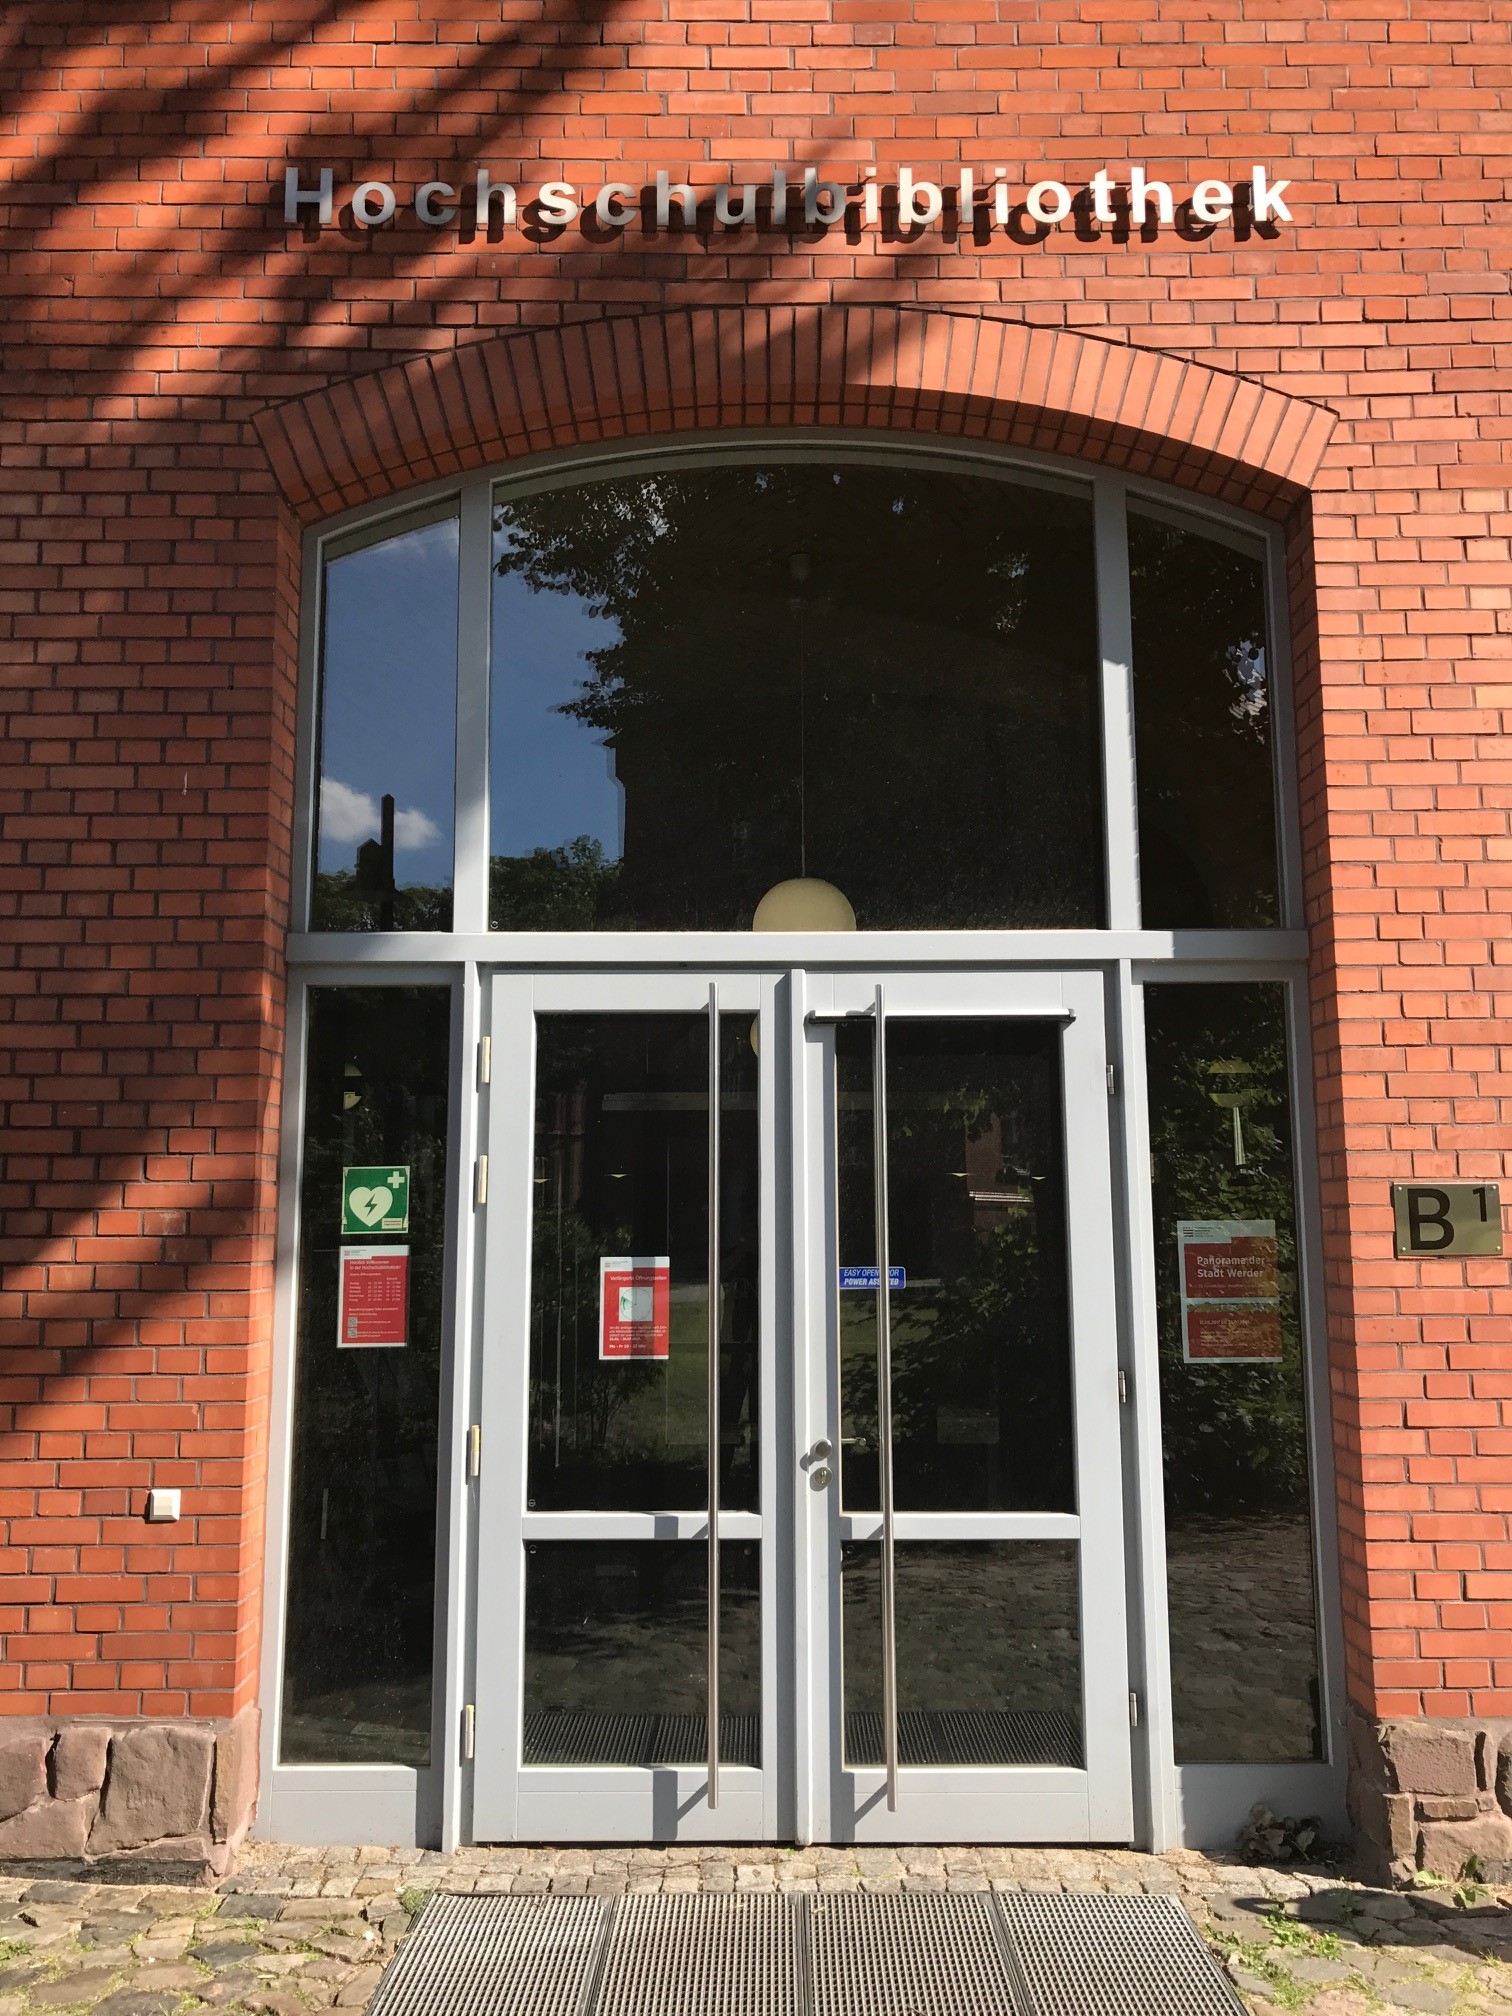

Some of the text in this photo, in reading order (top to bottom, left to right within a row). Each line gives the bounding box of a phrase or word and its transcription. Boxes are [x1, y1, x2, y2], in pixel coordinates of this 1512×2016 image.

[283, 165, 1294, 226] Hochschulbibliothek
[1407, 1186, 1488, 1251] B 1
[1196, 1255, 1266, 1265] Panorama der
[843, 1268, 862, 1277] EASY
[1197, 1268, 1264, 1278] Stadt Werder
[843, 1277, 868, 1286] POWER
